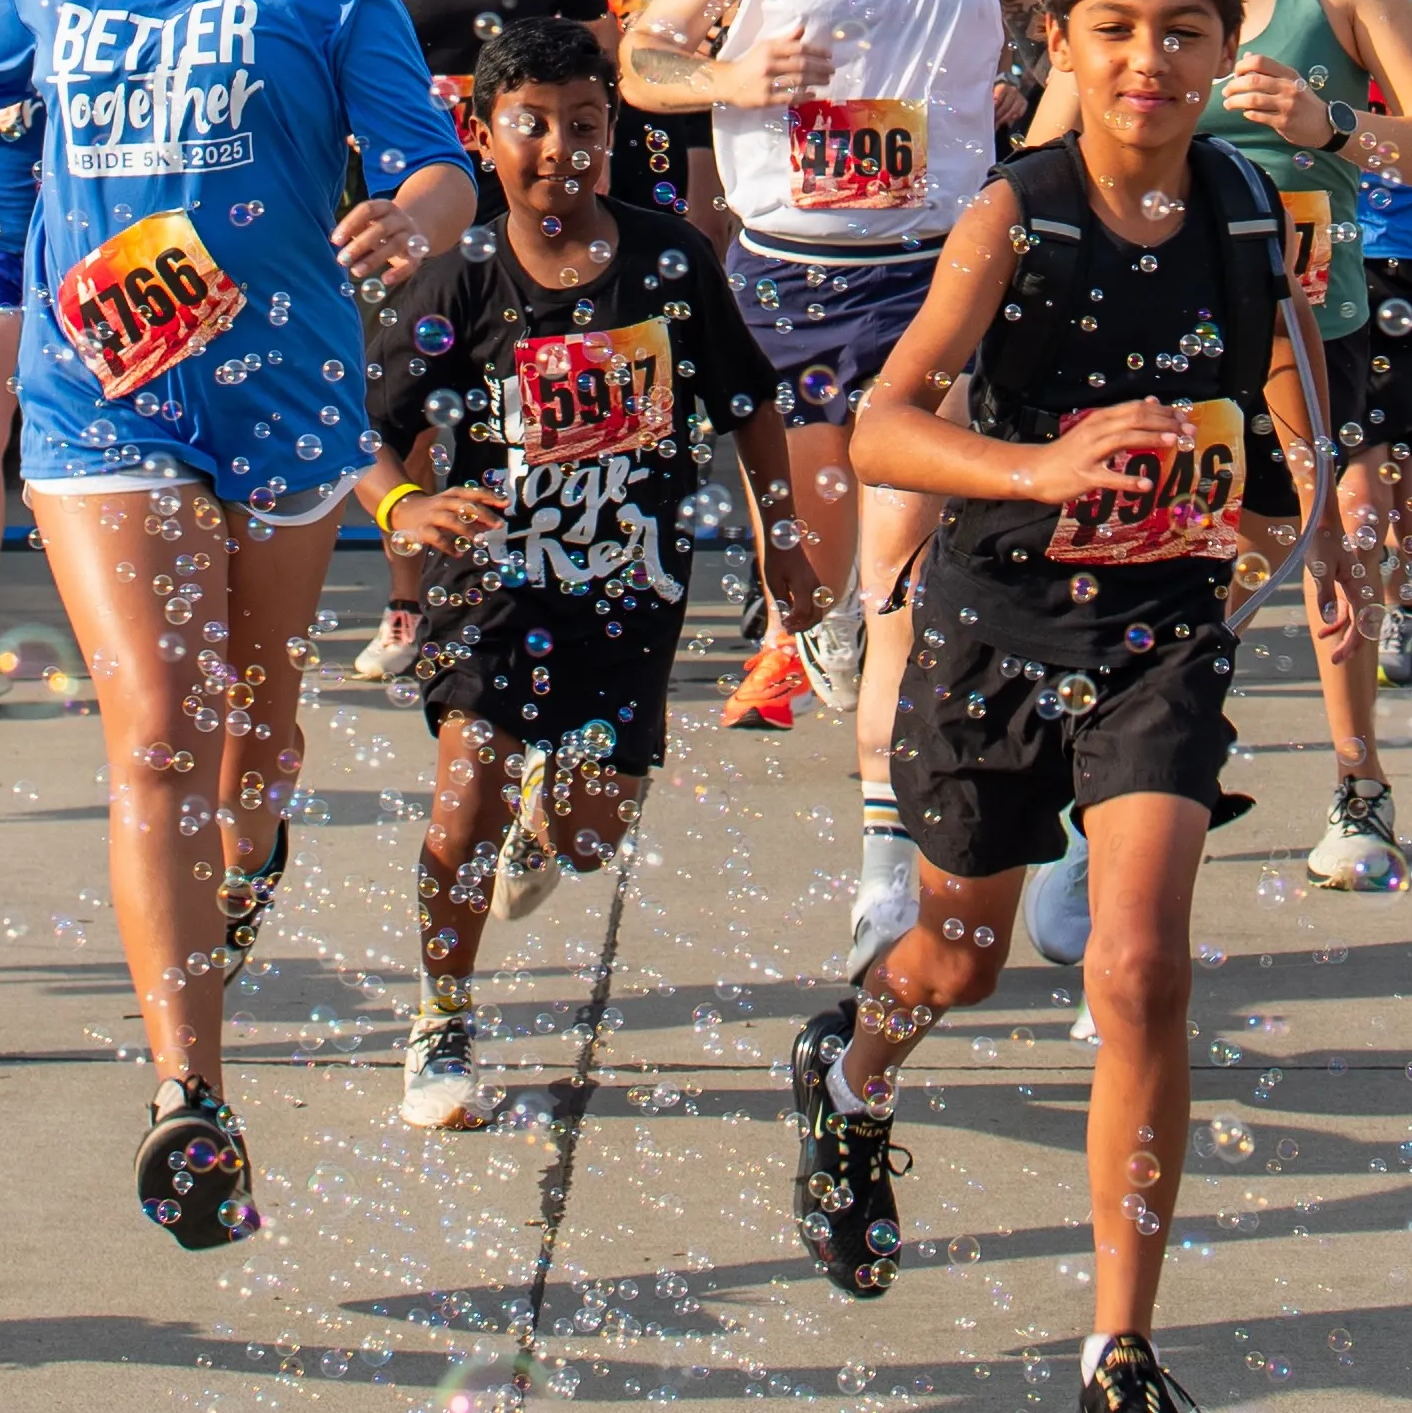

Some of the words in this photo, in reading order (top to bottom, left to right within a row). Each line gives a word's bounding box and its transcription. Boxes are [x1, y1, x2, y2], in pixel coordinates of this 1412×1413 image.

[191, 141, 243, 166] 2025
[801, 128, 913, 177] 4796
[80, 247, 209, 354] 4766
